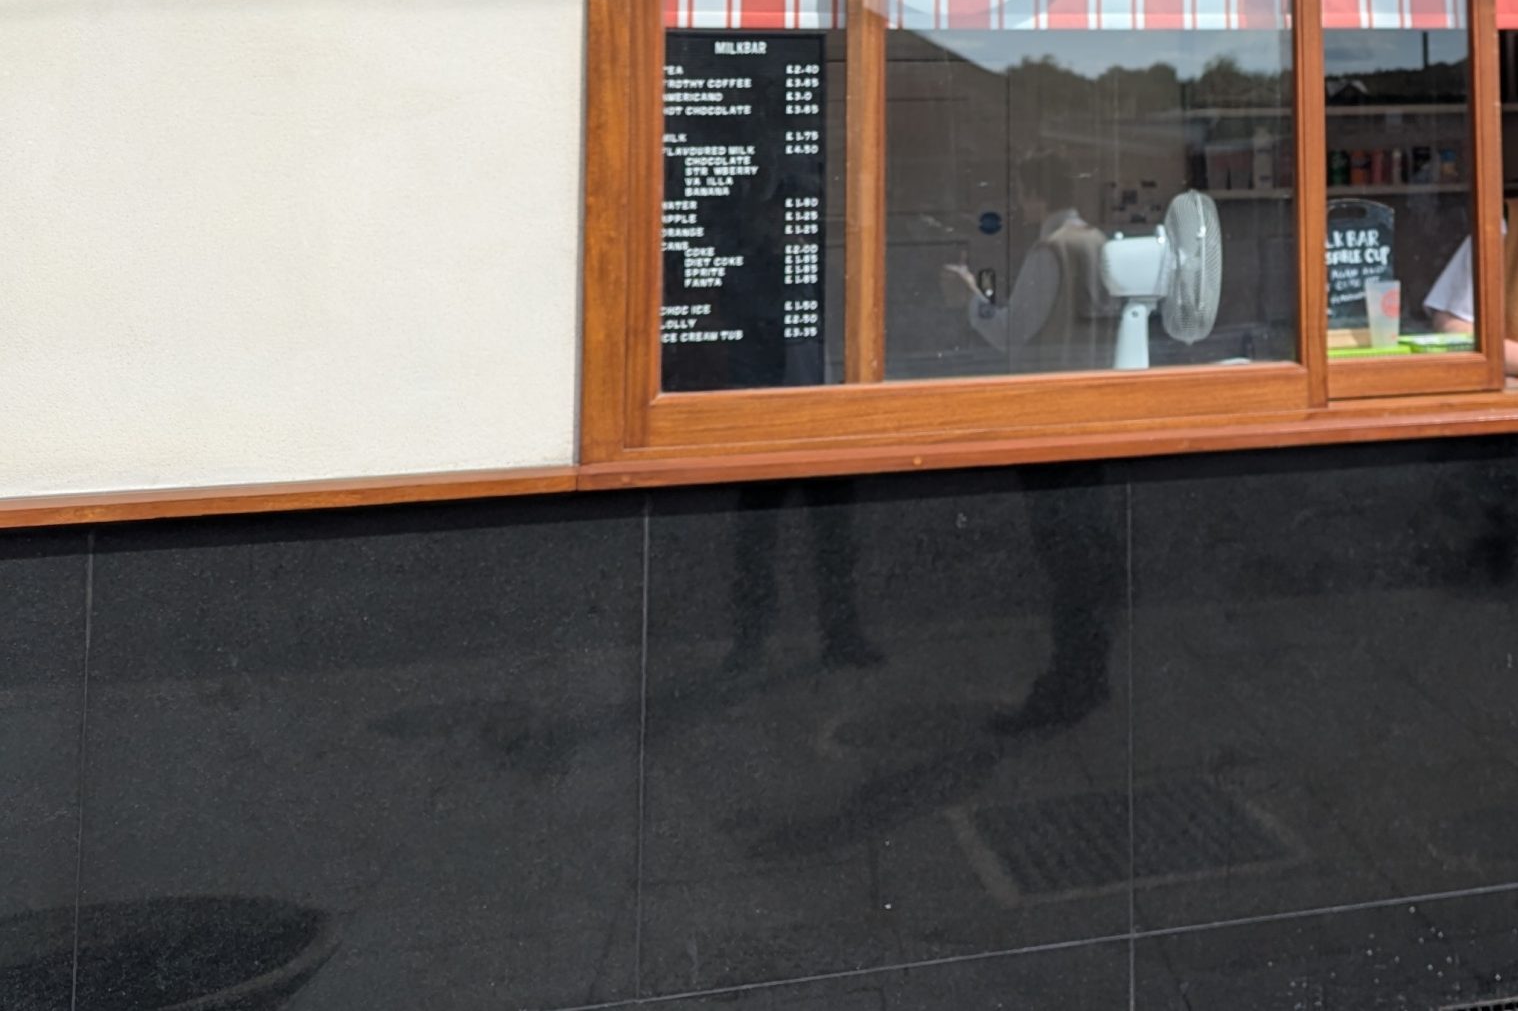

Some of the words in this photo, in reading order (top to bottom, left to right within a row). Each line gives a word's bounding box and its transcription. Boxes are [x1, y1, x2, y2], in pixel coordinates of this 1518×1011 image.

[715, 42, 766, 54] MILKBAR
[707, 78, 751, 88] COFFEE
[685, 105, 751, 115] CHOCOLATE
[728, 146, 755, 155] MILK
[685, 157, 751, 166] CHOCOLATE
[685, 187, 729, 196] BANANA
[1346, 229, 1379, 248] BAR
[684, 247, 715, 257] COKE
[684, 257, 712, 268] DIET
[713, 256, 744, 267] COKE
[685, 267, 726, 278] SPRITE
[685, 278, 722, 287] FANTA
[691, 305, 710, 314] ICE
[662, 333, 677, 343] CE
[680, 332, 718, 342] CREAM
[720, 330, 743, 340] TUB
